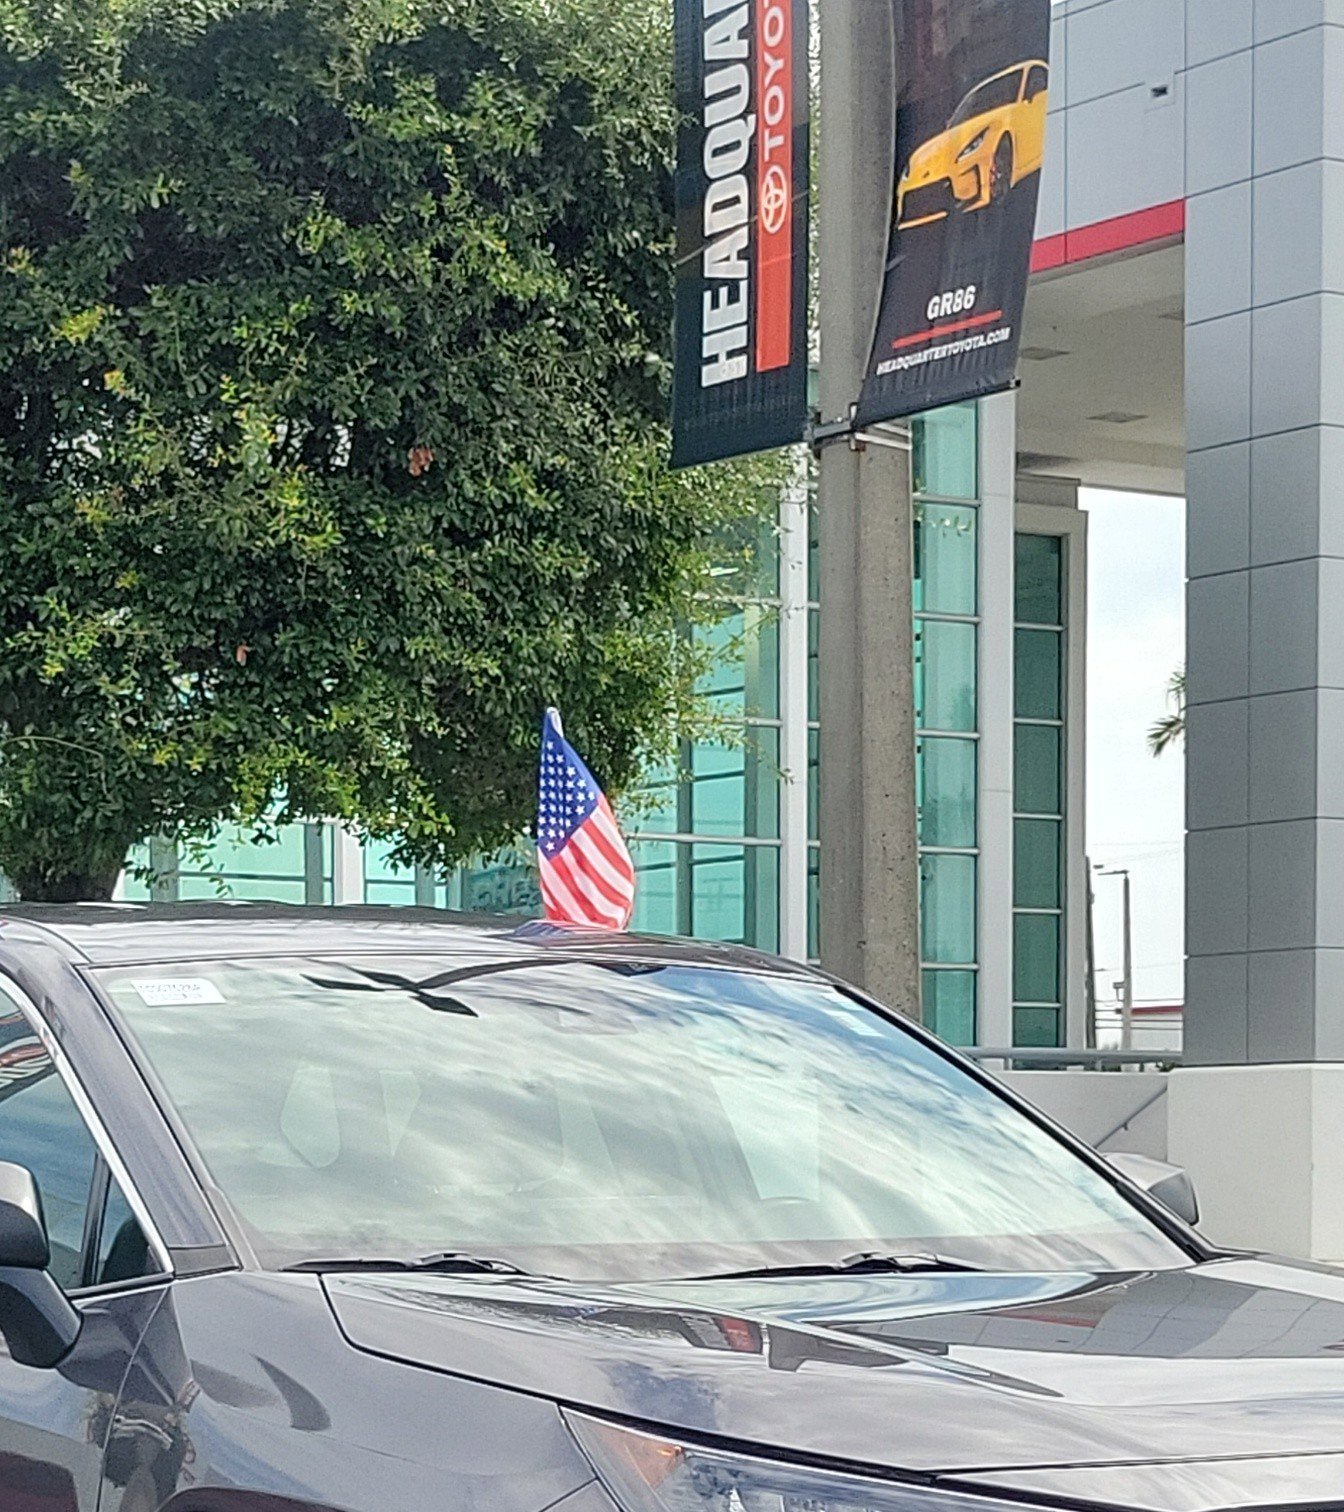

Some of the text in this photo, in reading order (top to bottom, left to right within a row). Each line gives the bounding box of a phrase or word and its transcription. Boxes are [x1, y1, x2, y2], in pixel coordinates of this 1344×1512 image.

[763, 0, 785, 162] TOYO
[927, 285, 976, 320] GR86
[876, 326, 1011, 376] HEADQUARTERTOYOTA.COM
